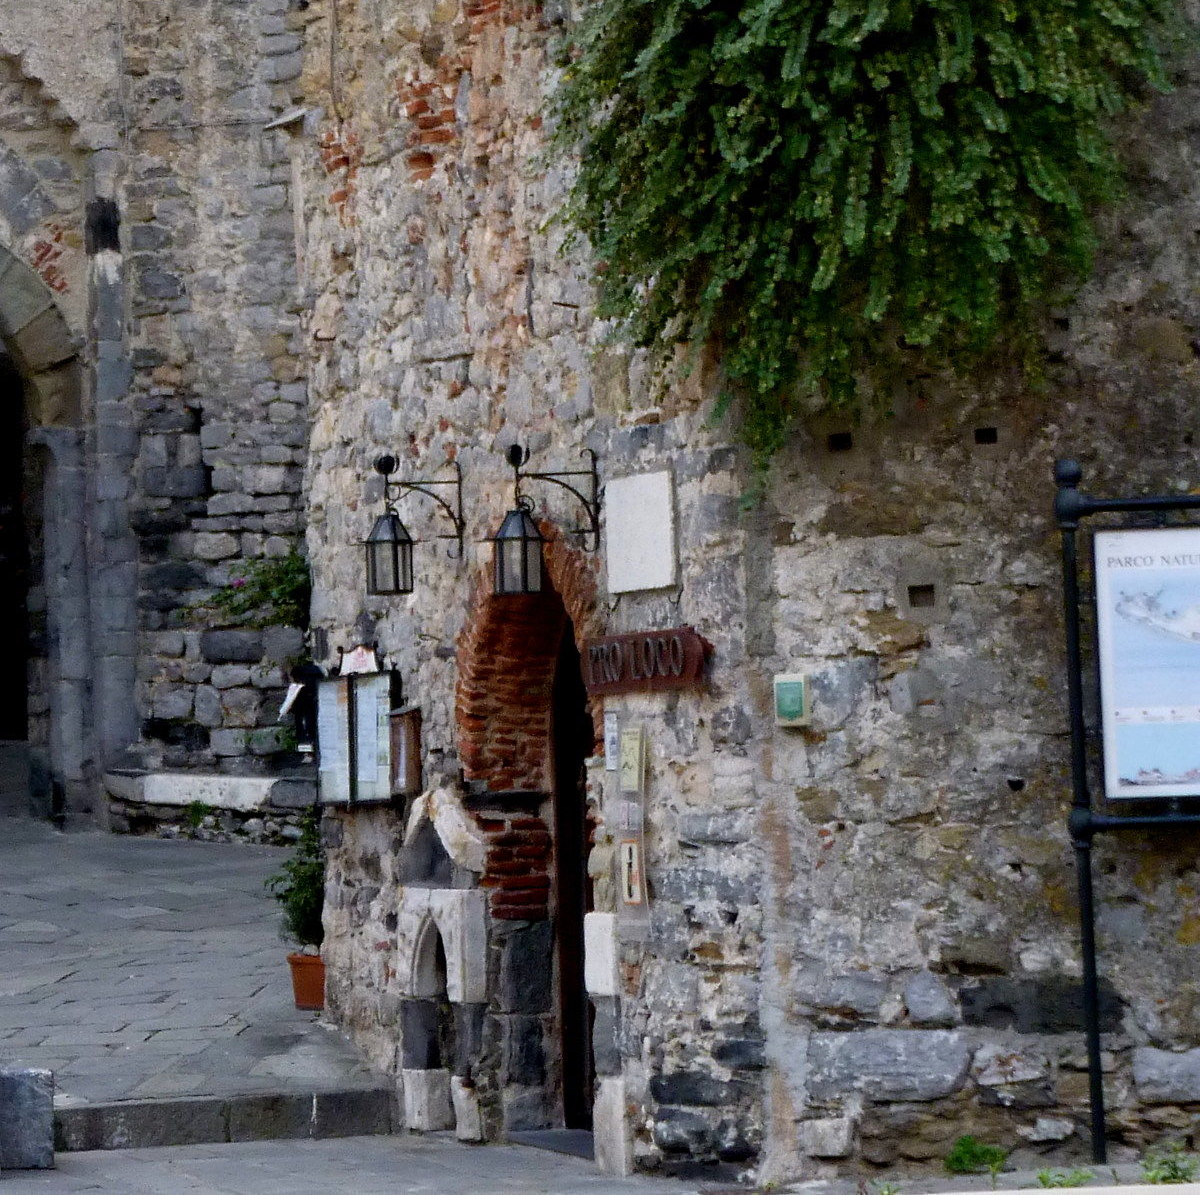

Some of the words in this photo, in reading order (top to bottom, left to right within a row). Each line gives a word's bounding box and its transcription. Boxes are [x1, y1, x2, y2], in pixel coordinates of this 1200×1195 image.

[1107, 555, 1154, 568] PARCO
[1160, 554, 1200, 566] NATU
[588, 642, 623, 685] PRO
[630, 636, 684, 680] LOCO
